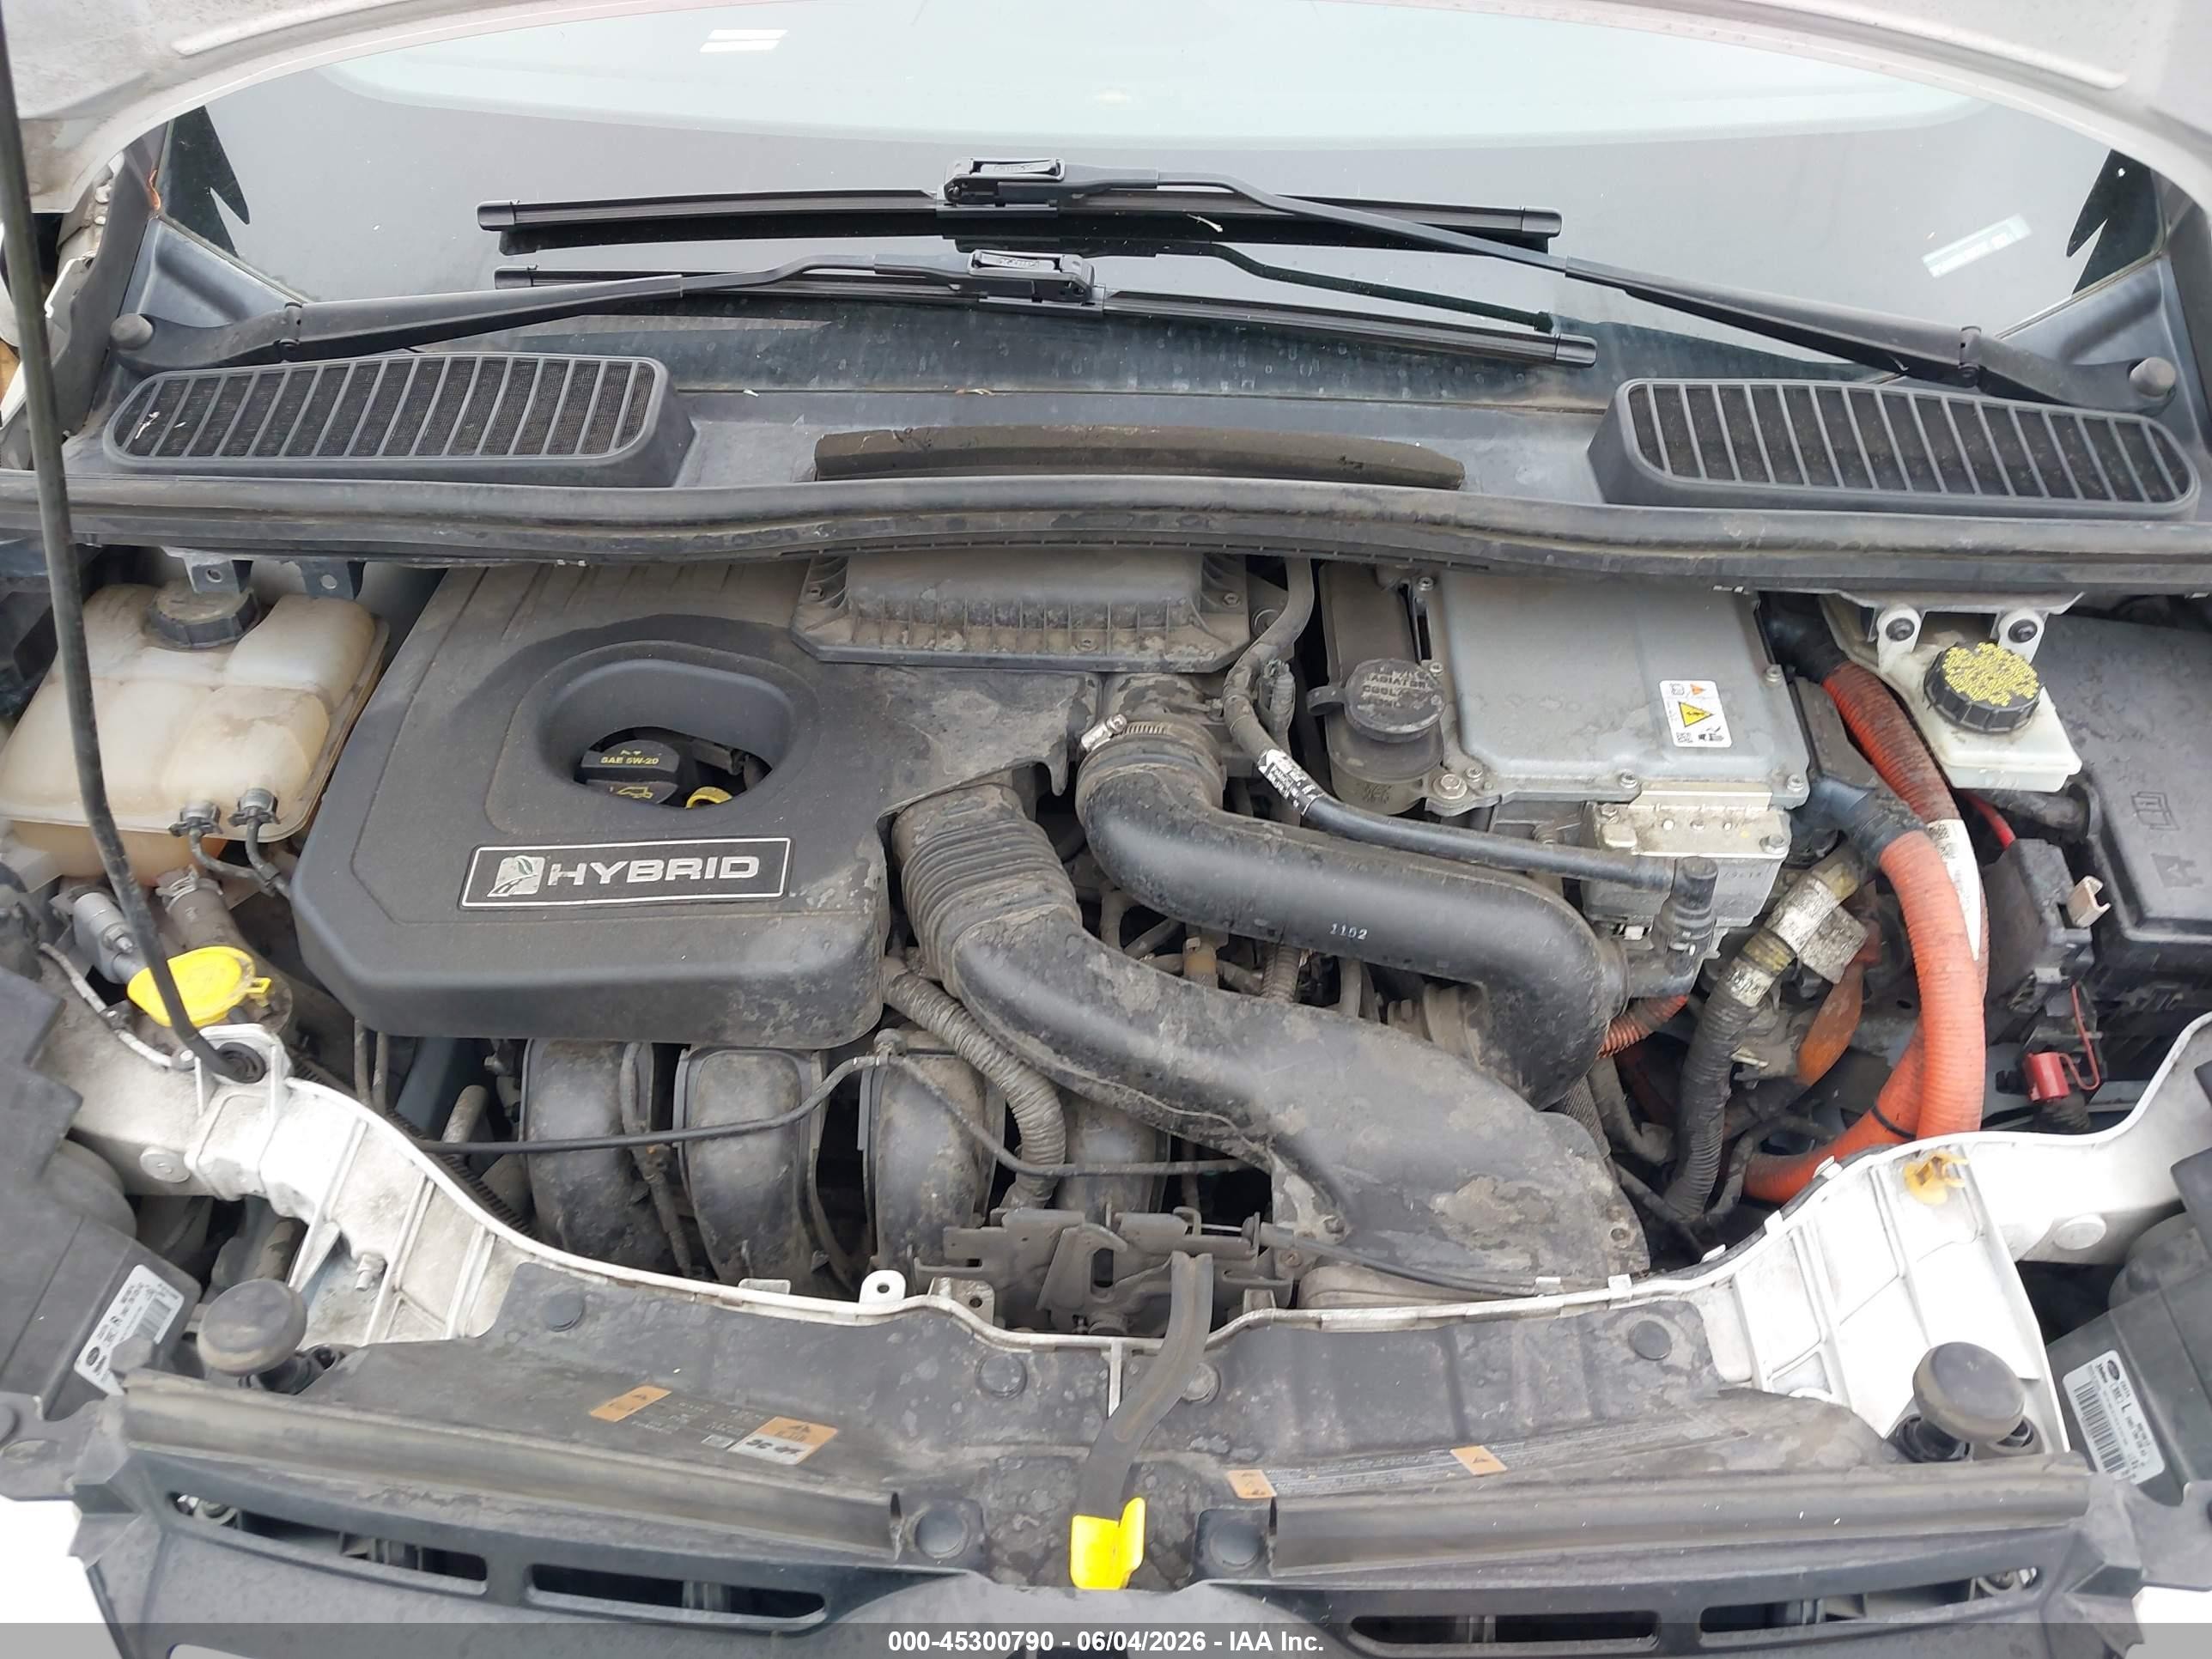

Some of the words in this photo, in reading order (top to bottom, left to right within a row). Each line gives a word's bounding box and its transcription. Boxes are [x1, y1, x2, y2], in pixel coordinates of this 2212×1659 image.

[1364, 673, 1426, 689] ADIATOR
[625, 757, 659, 765] 5W-20
[547, 855, 760, 886] HYBRID
[1329, 922, 1368, 941] 1102
